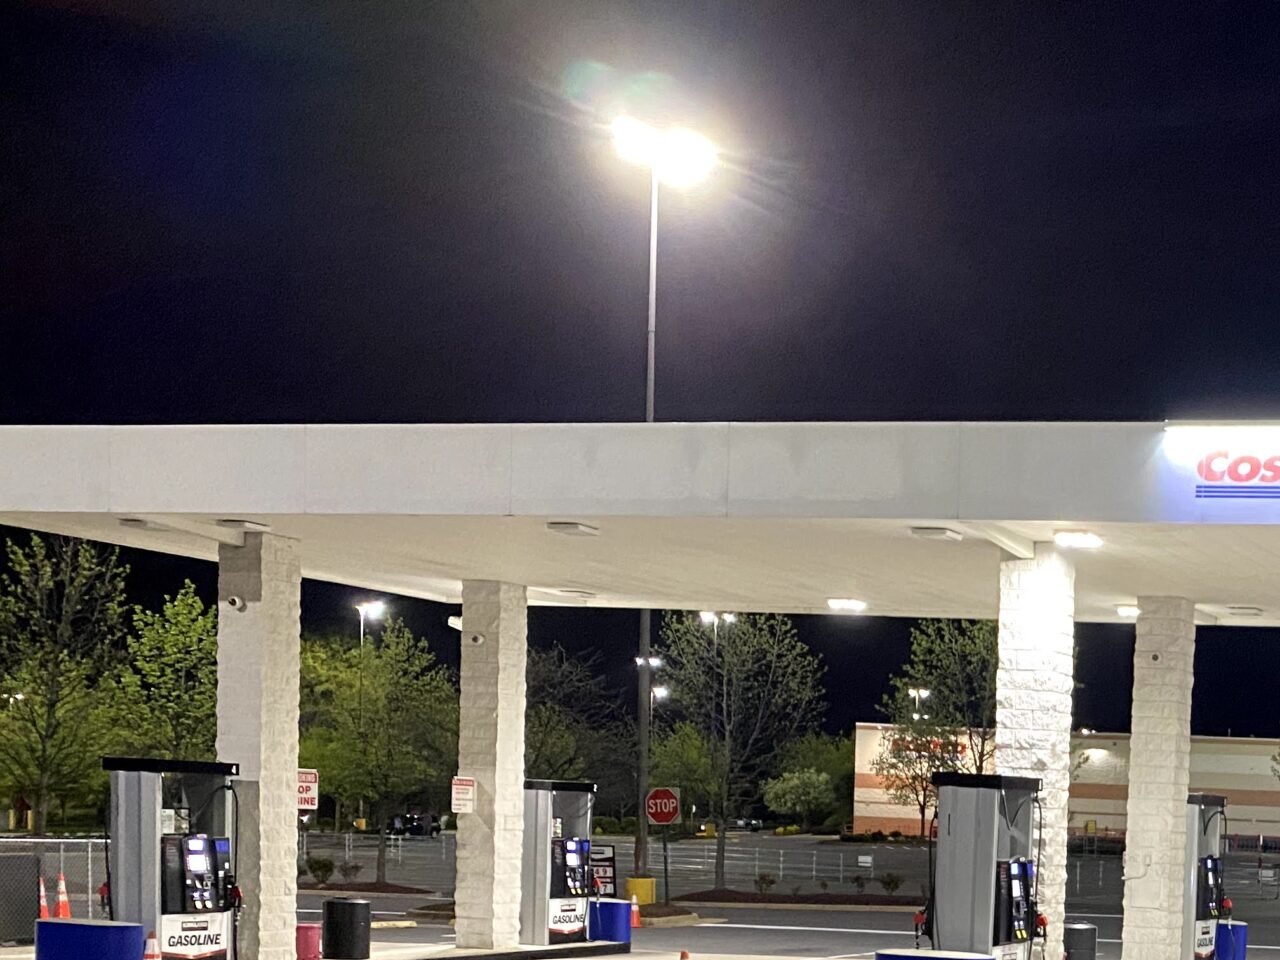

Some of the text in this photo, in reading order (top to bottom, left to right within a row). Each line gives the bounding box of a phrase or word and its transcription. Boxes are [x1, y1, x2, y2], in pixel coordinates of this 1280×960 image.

[297, 785, 312, 794] OP
[648, 799, 677, 813] STOP
[552, 914, 584, 924] GASOLINE
[168, 933, 222, 947] GASOLINE
